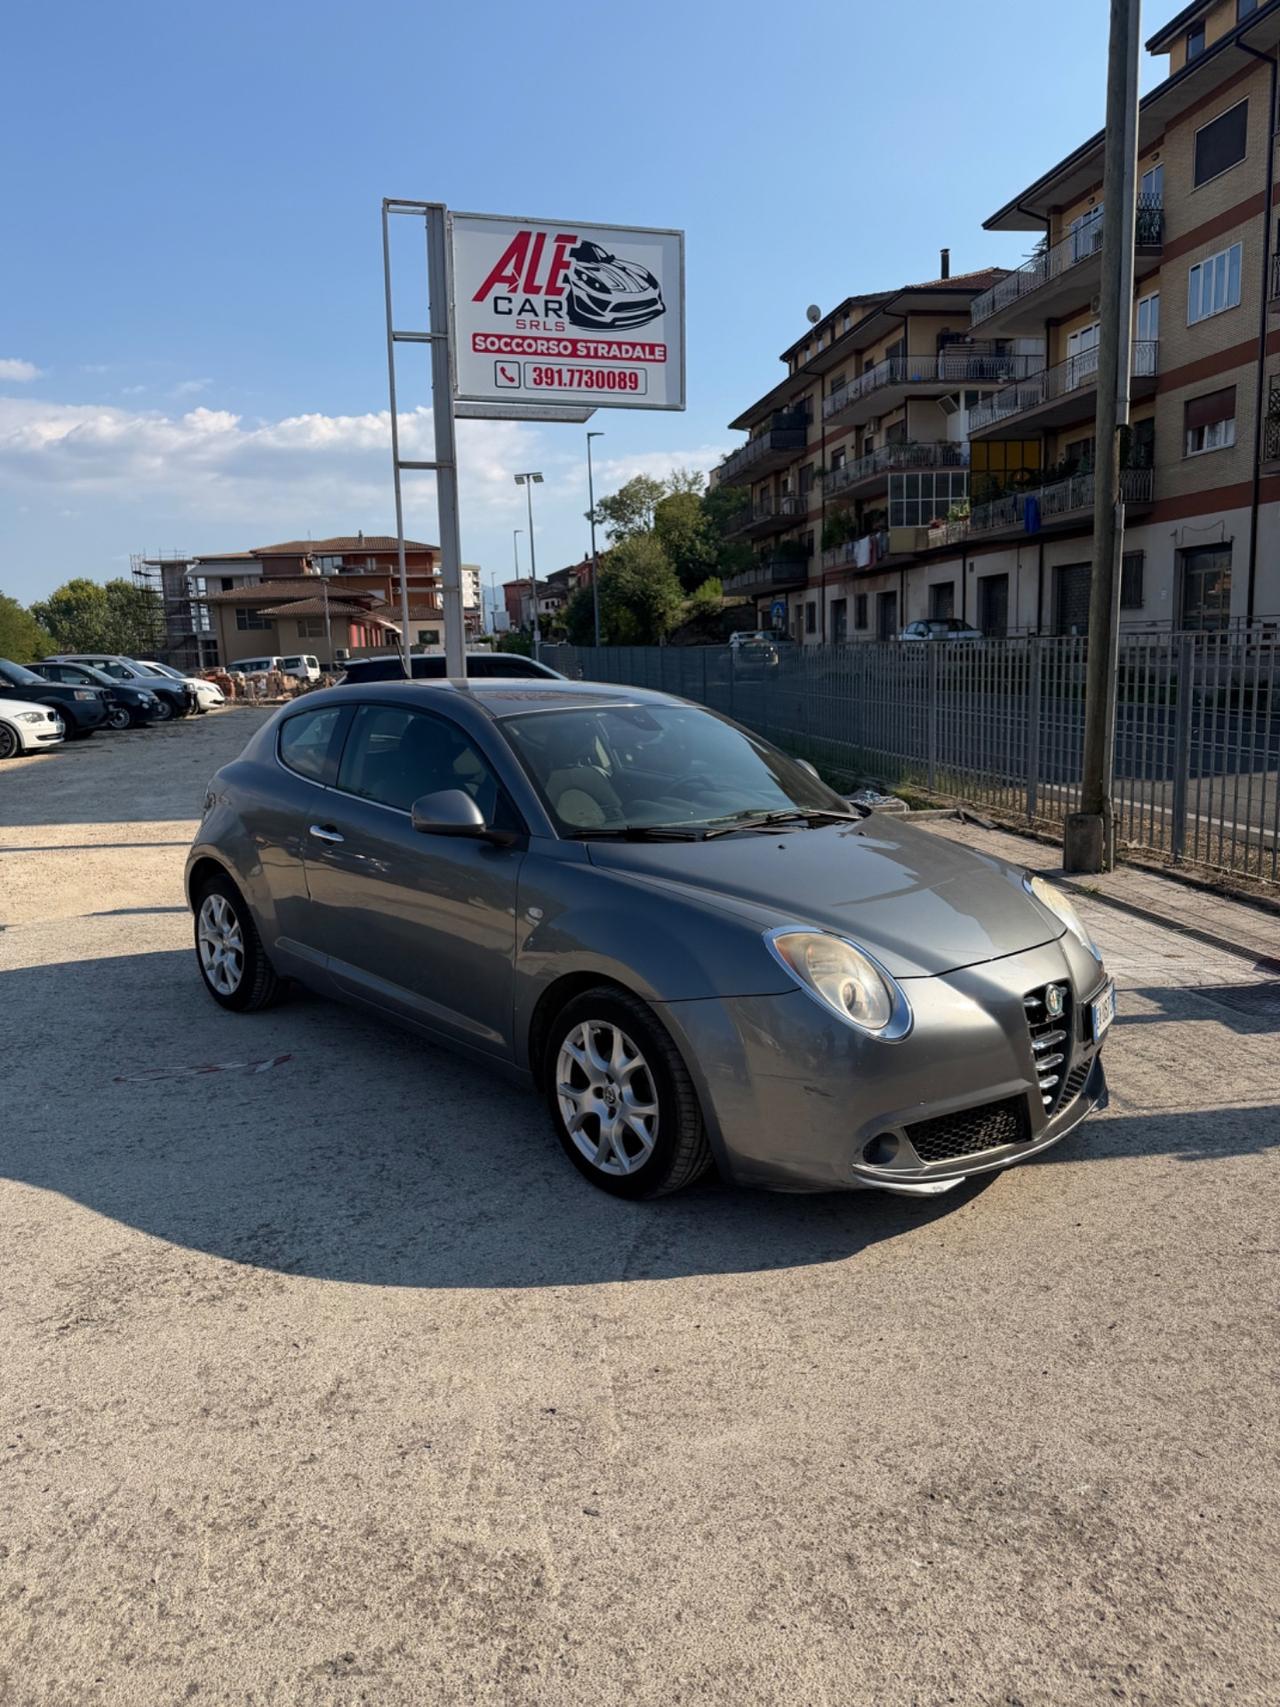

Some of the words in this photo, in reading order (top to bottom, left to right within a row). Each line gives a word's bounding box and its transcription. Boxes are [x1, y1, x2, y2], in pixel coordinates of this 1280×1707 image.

[472, 230, 578, 302] ALE
[493, 296, 563, 318] CAR
[515, 319, 565, 332] SRLS
[474, 336, 572, 355] SOCCORSO
[577, 341, 665, 360] STRADALE
[532, 366, 639, 390] 391.7730089
